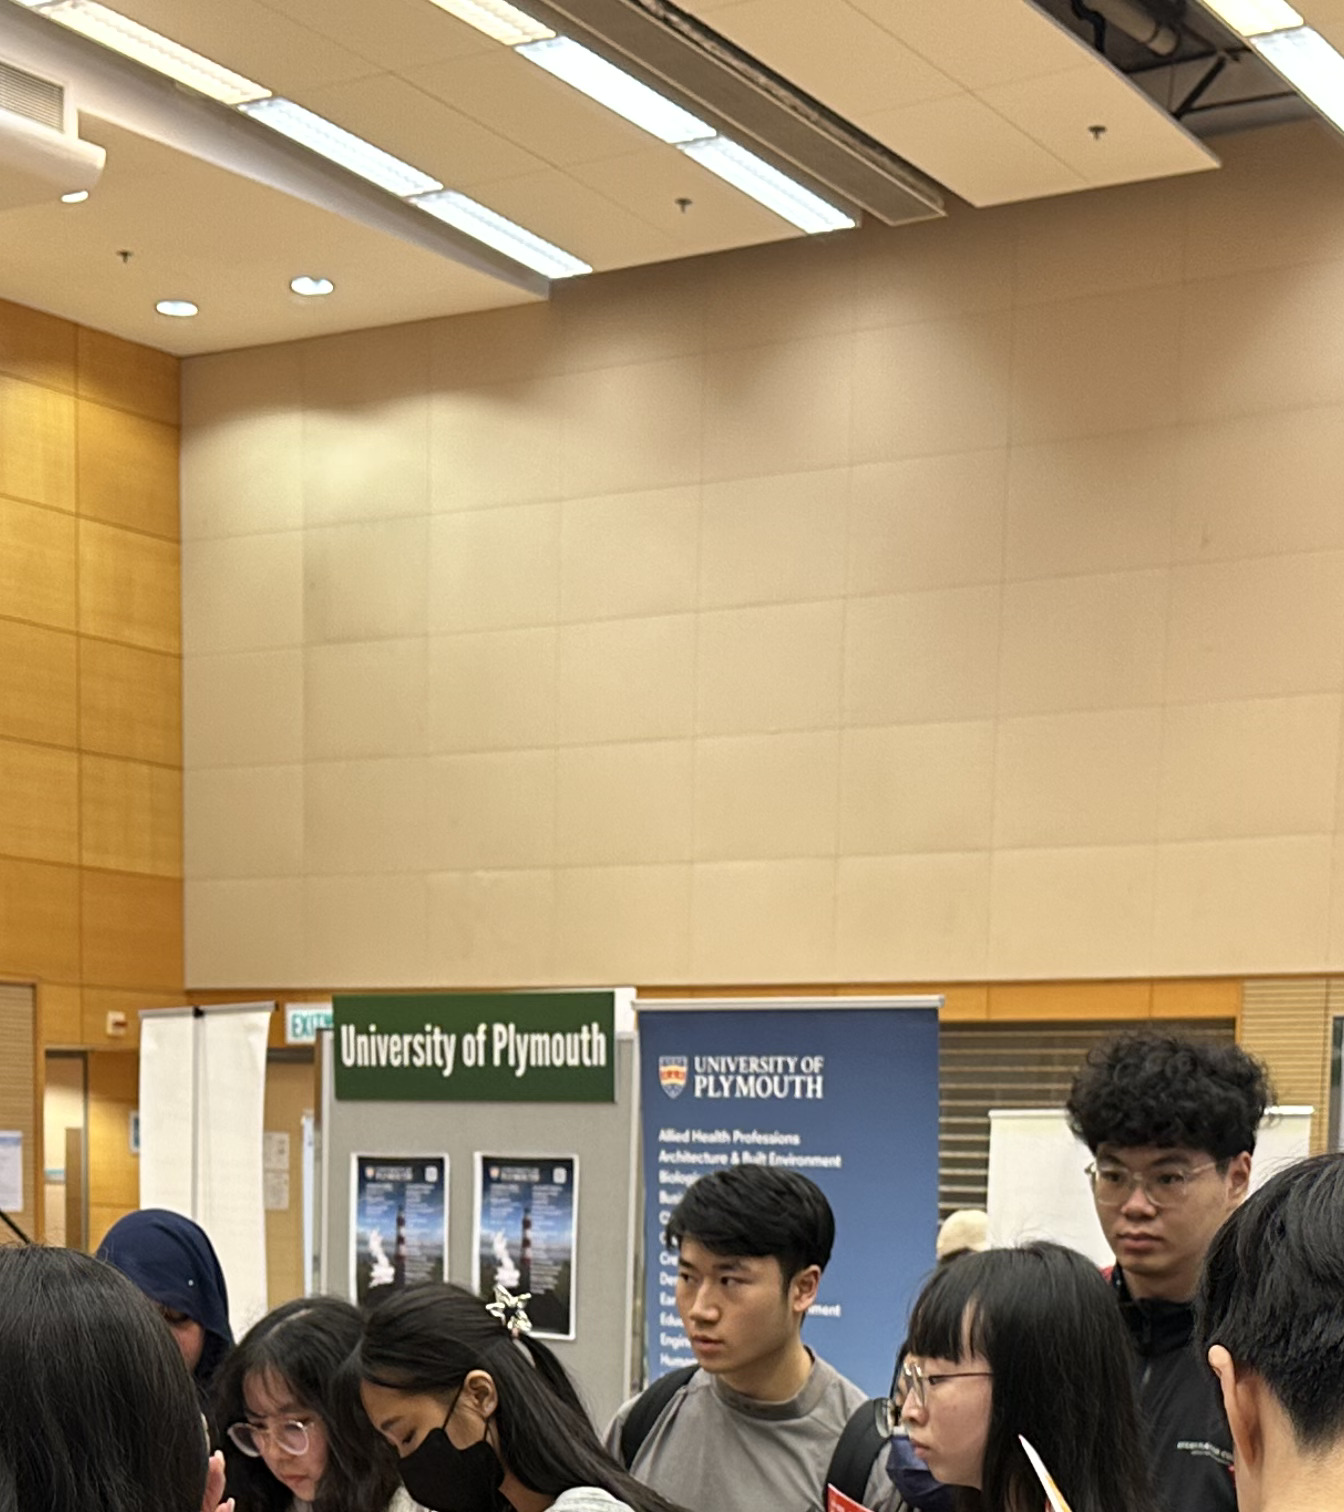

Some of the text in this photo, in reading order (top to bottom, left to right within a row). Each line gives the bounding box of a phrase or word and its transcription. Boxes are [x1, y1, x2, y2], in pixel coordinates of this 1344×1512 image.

[340, 1022, 606, 1077] University of Plymouth
[694, 1056, 824, 1074] UNIVERSITY OF
[694, 1075, 824, 1099] PLYMOUTH
[659, 1128, 801, 1146] Allied Health Professions
[659, 1150, 843, 1168] Architecture & Built Environment
